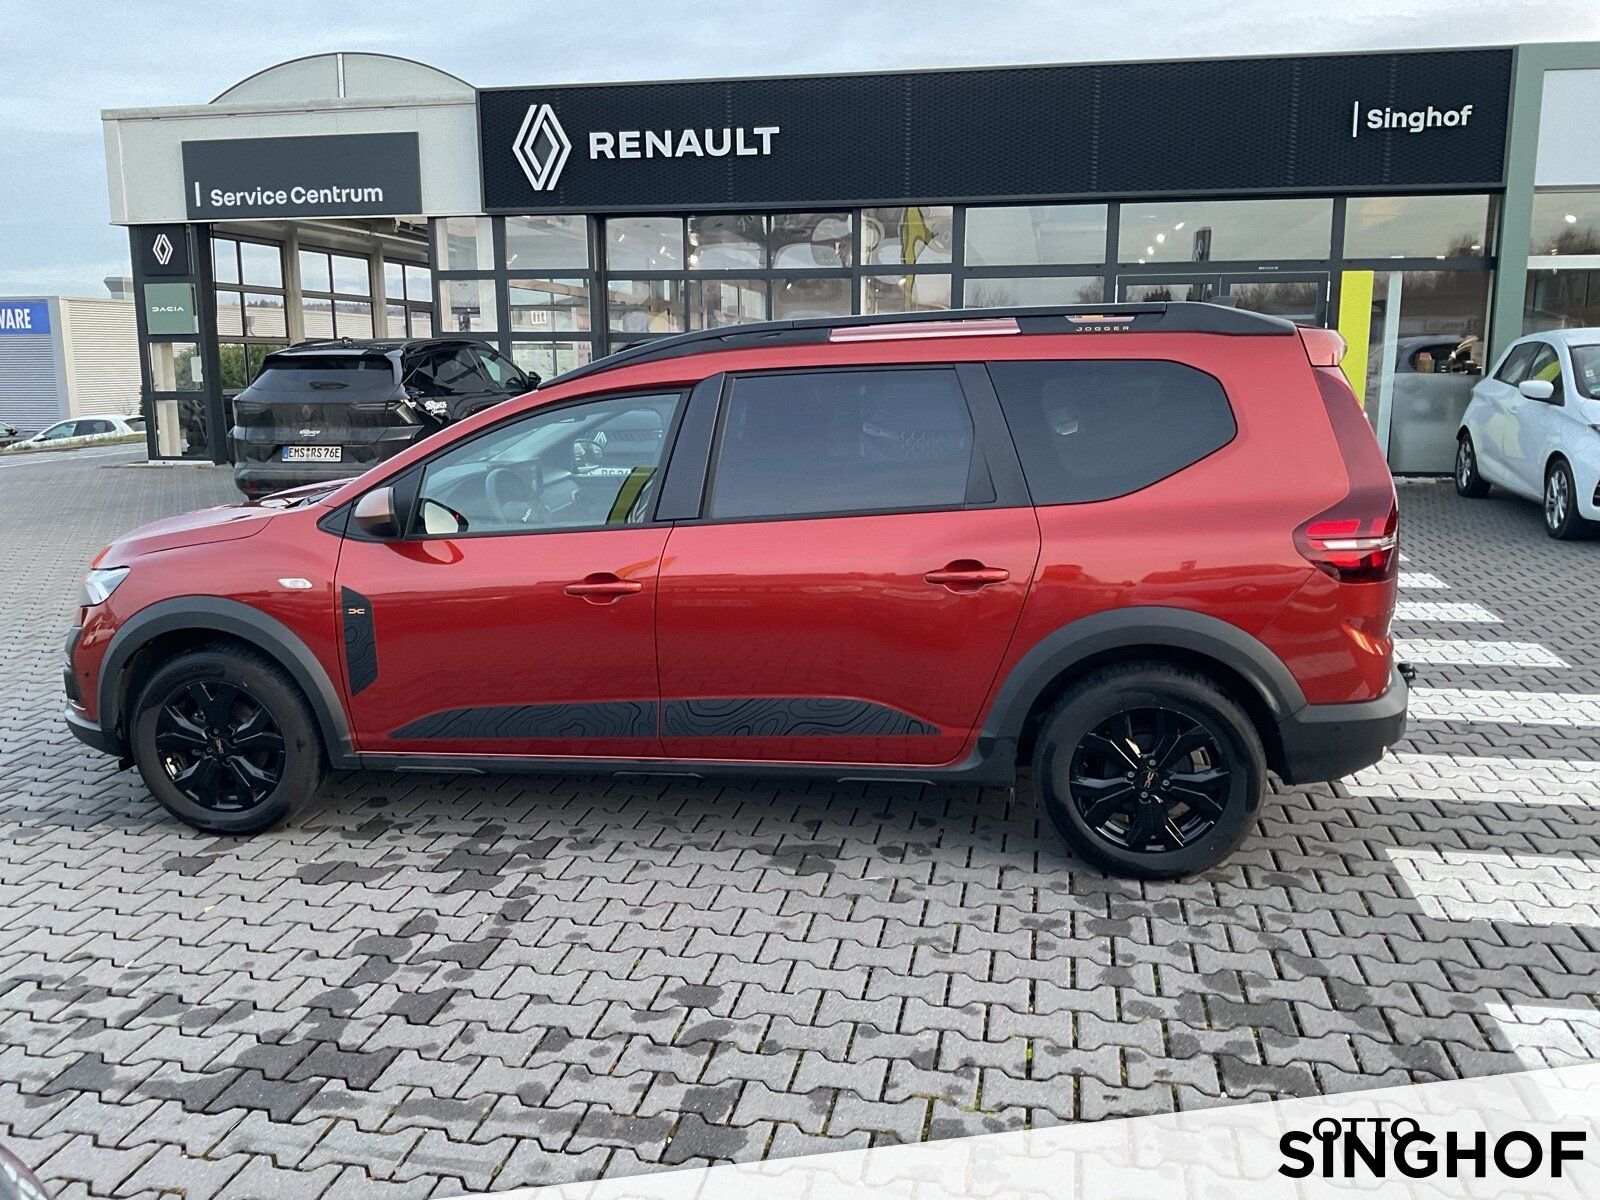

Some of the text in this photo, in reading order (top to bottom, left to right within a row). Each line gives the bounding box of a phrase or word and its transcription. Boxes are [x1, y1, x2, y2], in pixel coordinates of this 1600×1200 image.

[1367, 104, 1474, 133] Singhof
[588, 126, 780, 160] RENAULT
[210, 185, 384, 207] Service Centrum
[288, 447, 341, 458] EMS RS 76E
